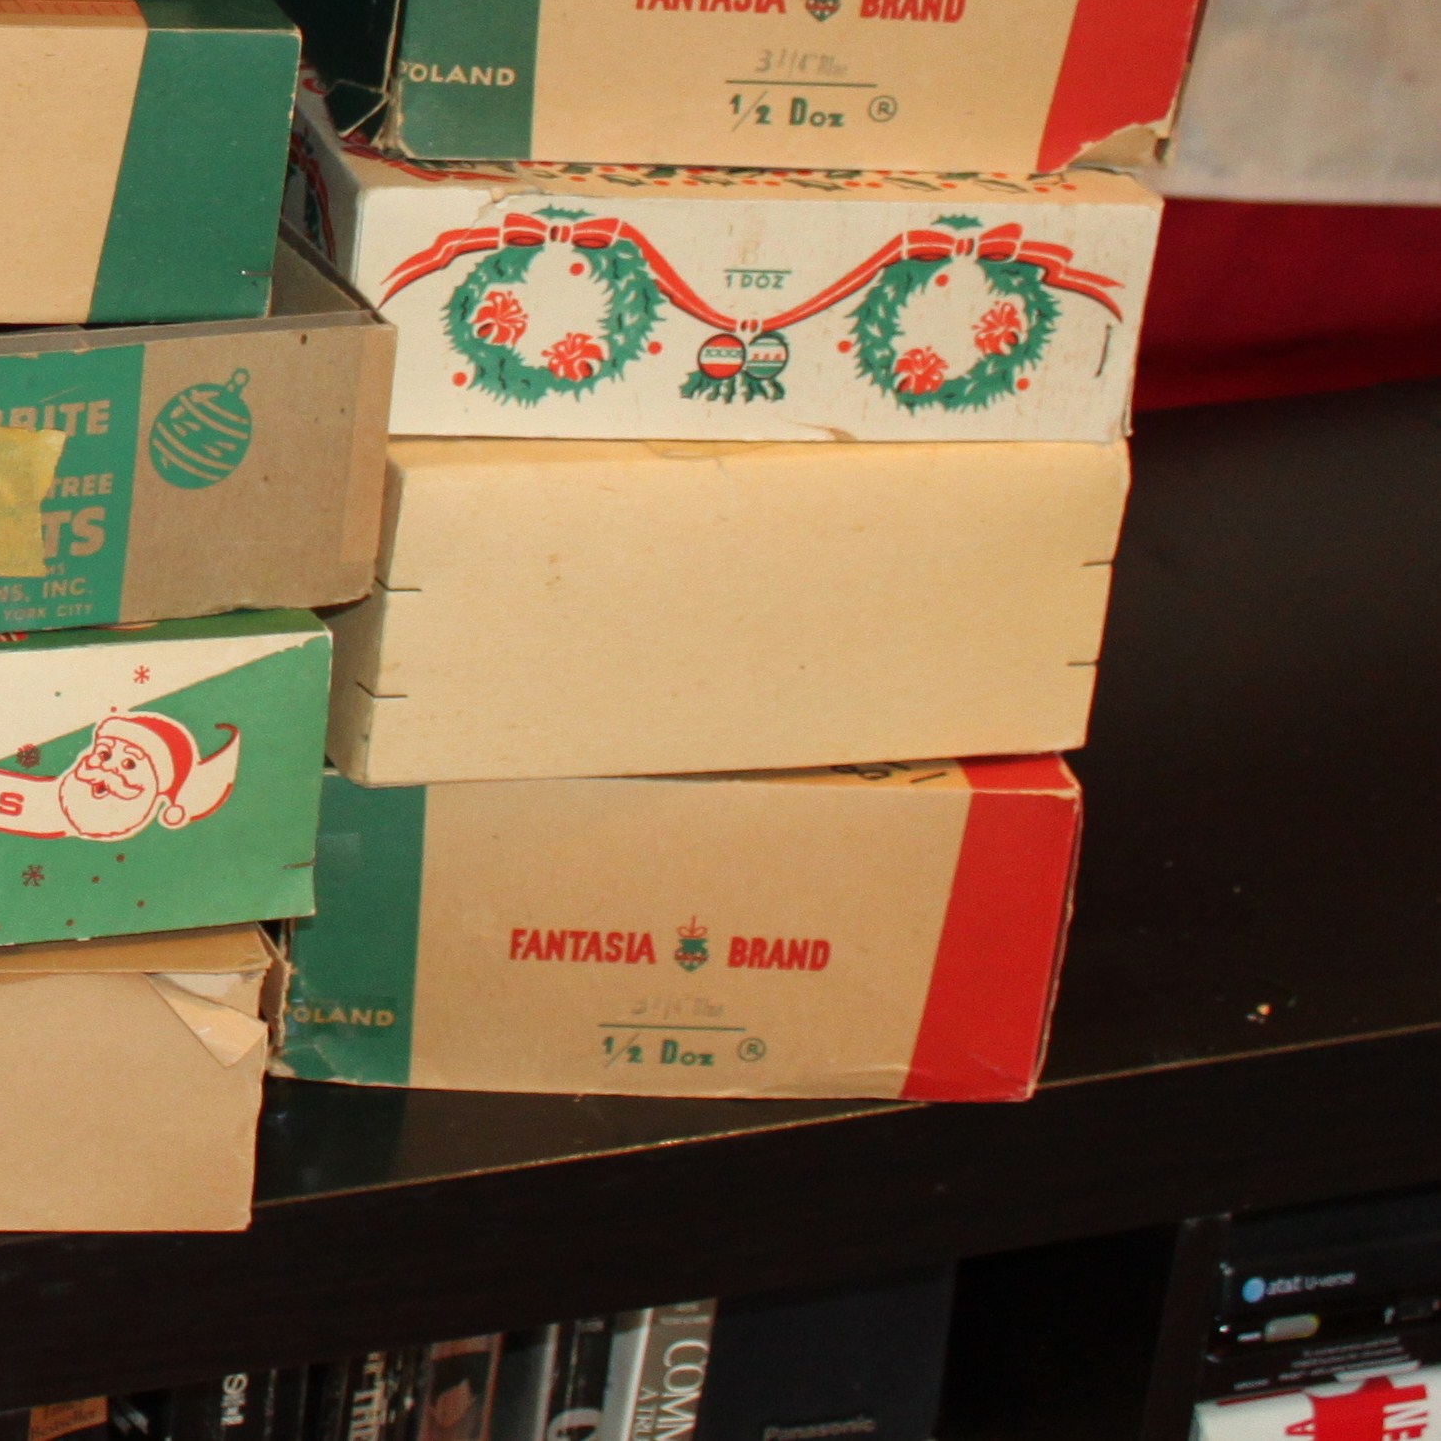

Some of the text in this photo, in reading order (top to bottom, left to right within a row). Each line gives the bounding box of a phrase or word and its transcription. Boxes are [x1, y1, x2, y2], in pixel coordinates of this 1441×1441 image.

[741, 274, 785, 289] DOZ
[42, 578, 92, 600] INC.
[4, 606, 47, 622] YORK
[57, 602, 93, 618] CITY
[509, 928, 830, 971] FANTASIA BRAND
